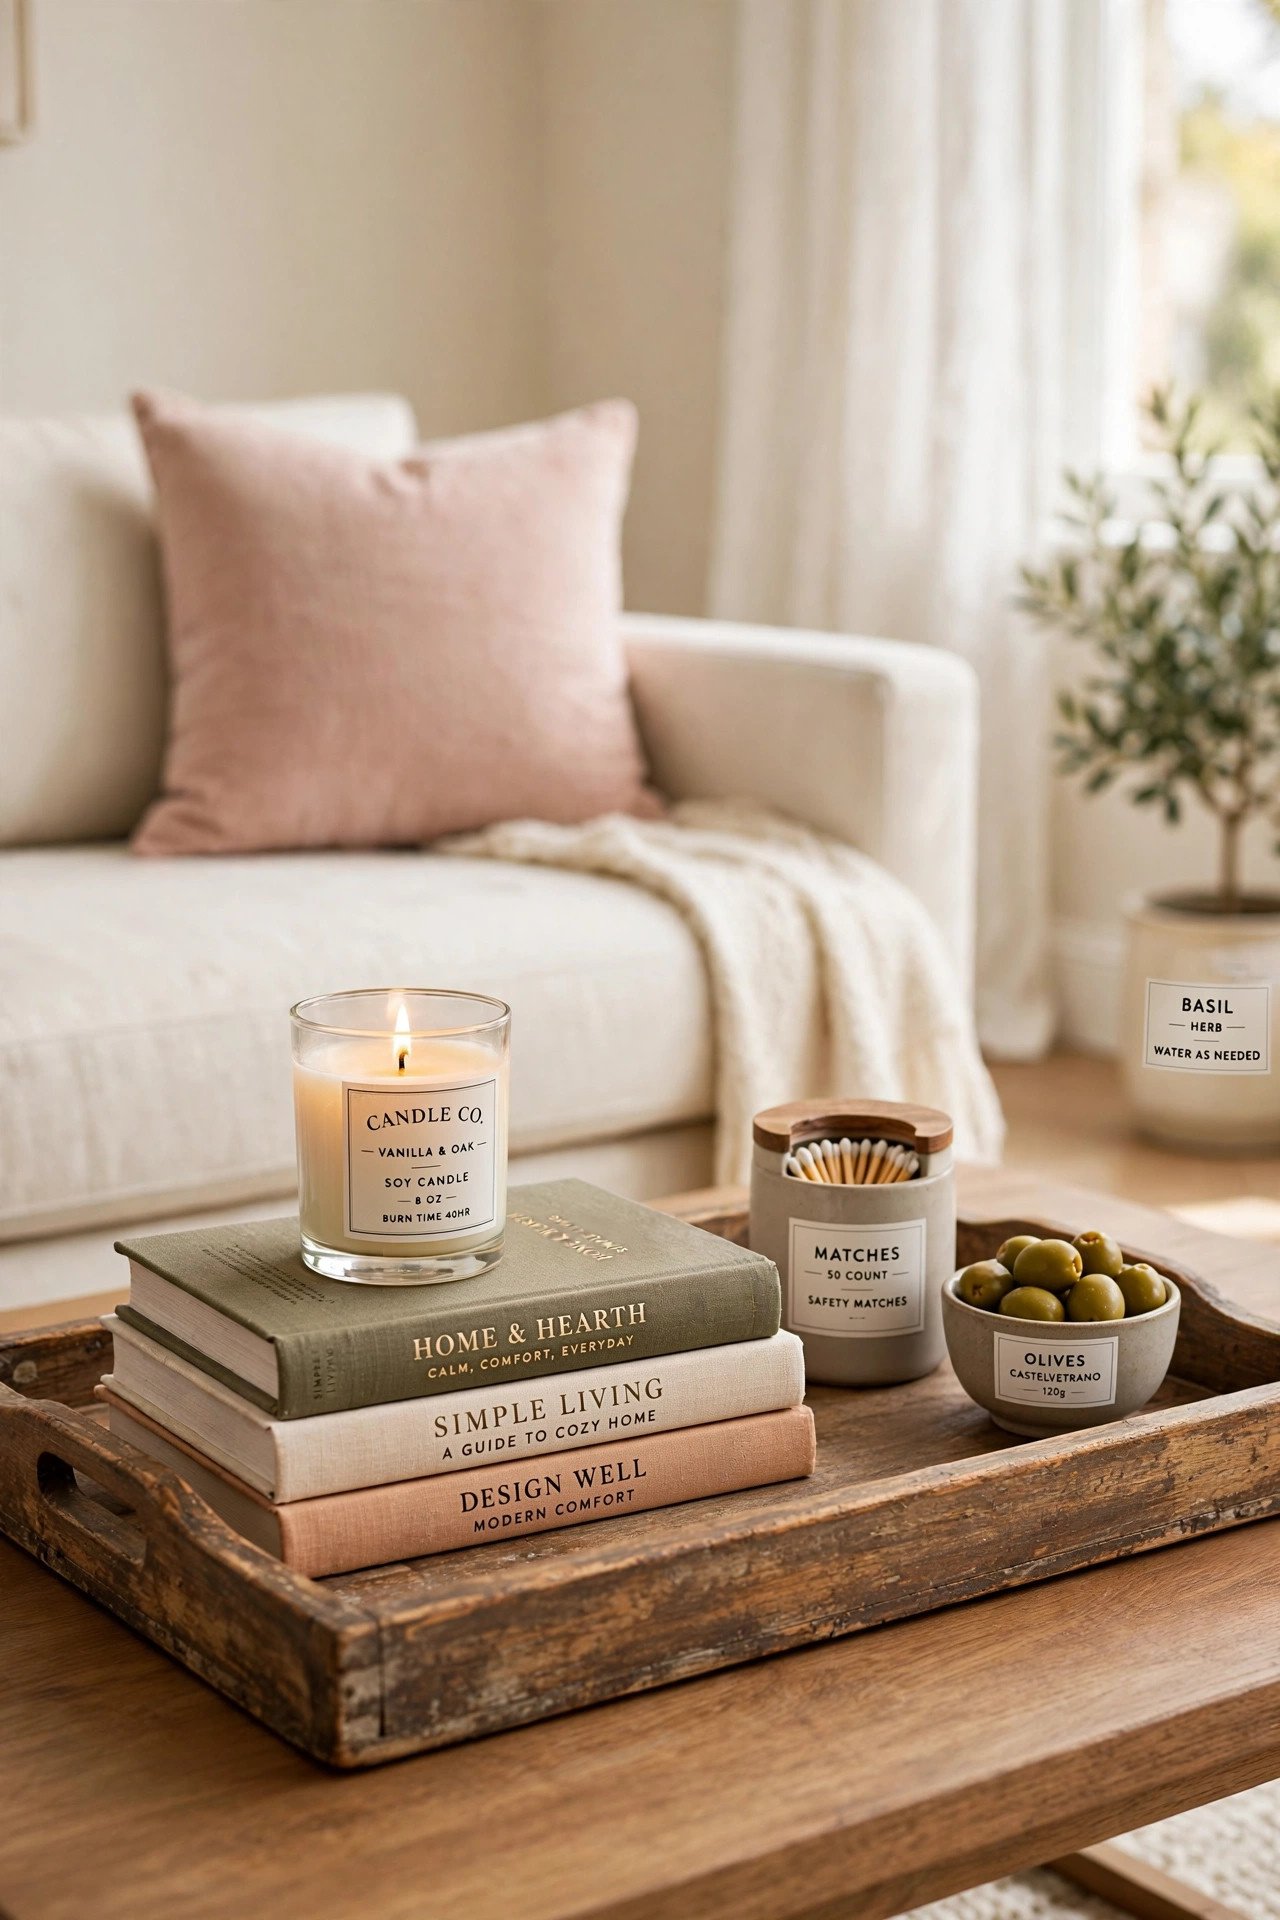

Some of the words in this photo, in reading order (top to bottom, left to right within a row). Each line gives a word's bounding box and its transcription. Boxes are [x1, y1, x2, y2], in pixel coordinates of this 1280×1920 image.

[1182, 997, 1234, 1014] BASIL
[1190, 1021, 1223, 1032] HERB
[1154, 1045, 1192, 1058] WATER
[1195, 1050, 1210, 1060] AS
[1214, 1050, 1261, 1061] NEEDED
[366, 1106, 451, 1131] CANDLE
[458, 1106, 484, 1124] CO.
[378, 1147, 433, 1158] VANILLA
[438, 1146, 446, 1156] &
[451, 1142, 475, 1154] OAK
[384, 1177, 411, 1188] SOY
[417, 1172, 469, 1187] CANDLE
[415, 1196, 421, 1205] 8
[426, 1194, 442, 1204] OZ
[382, 1214, 412, 1223] BURN
[416, 1213, 442, 1222] TIME
[445, 1208, 470, 1219] 40HR
[814, 1246, 900, 1262] MATCHES
[827, 1270, 841, 1280] 50
[845, 1270, 888, 1281] COUNT
[808, 1295, 850, 1308] SAFETY
[853, 1296, 908, 1309] MATCHES
[413, 1326, 498, 1361] HOME
[508, 1323, 527, 1344] &
[536, 1302, 647, 1341] HEARTH
[427, 1361, 474, 1379] CALM,
[480, 1349, 555, 1370] COMFORT,
[561, 1334, 634, 1357] EVERYDAY
[1024, 1352, 1085, 1367] OLIVES
[1009, 1369, 1101, 1383] CASTELVETRANO
[1042, 1387, 1066, 1399] 120g
[434, 1398, 547, 1438] SIMPLE
[560, 1377, 664, 1416] LIVING
[442, 1447, 453, 1460] A
[461, 1434, 516, 1457] GUIDE
[525, 1430, 547, 1444] TO
[555, 1419, 600, 1439] COZY
[608, 1409, 656, 1429] HOME
[460, 1473, 562, 1513] DESIGN
[573, 1458, 647, 1489] WELL
[473, 1507, 546, 1533] MODERN
[555, 1489, 635, 1515] COMFORT
